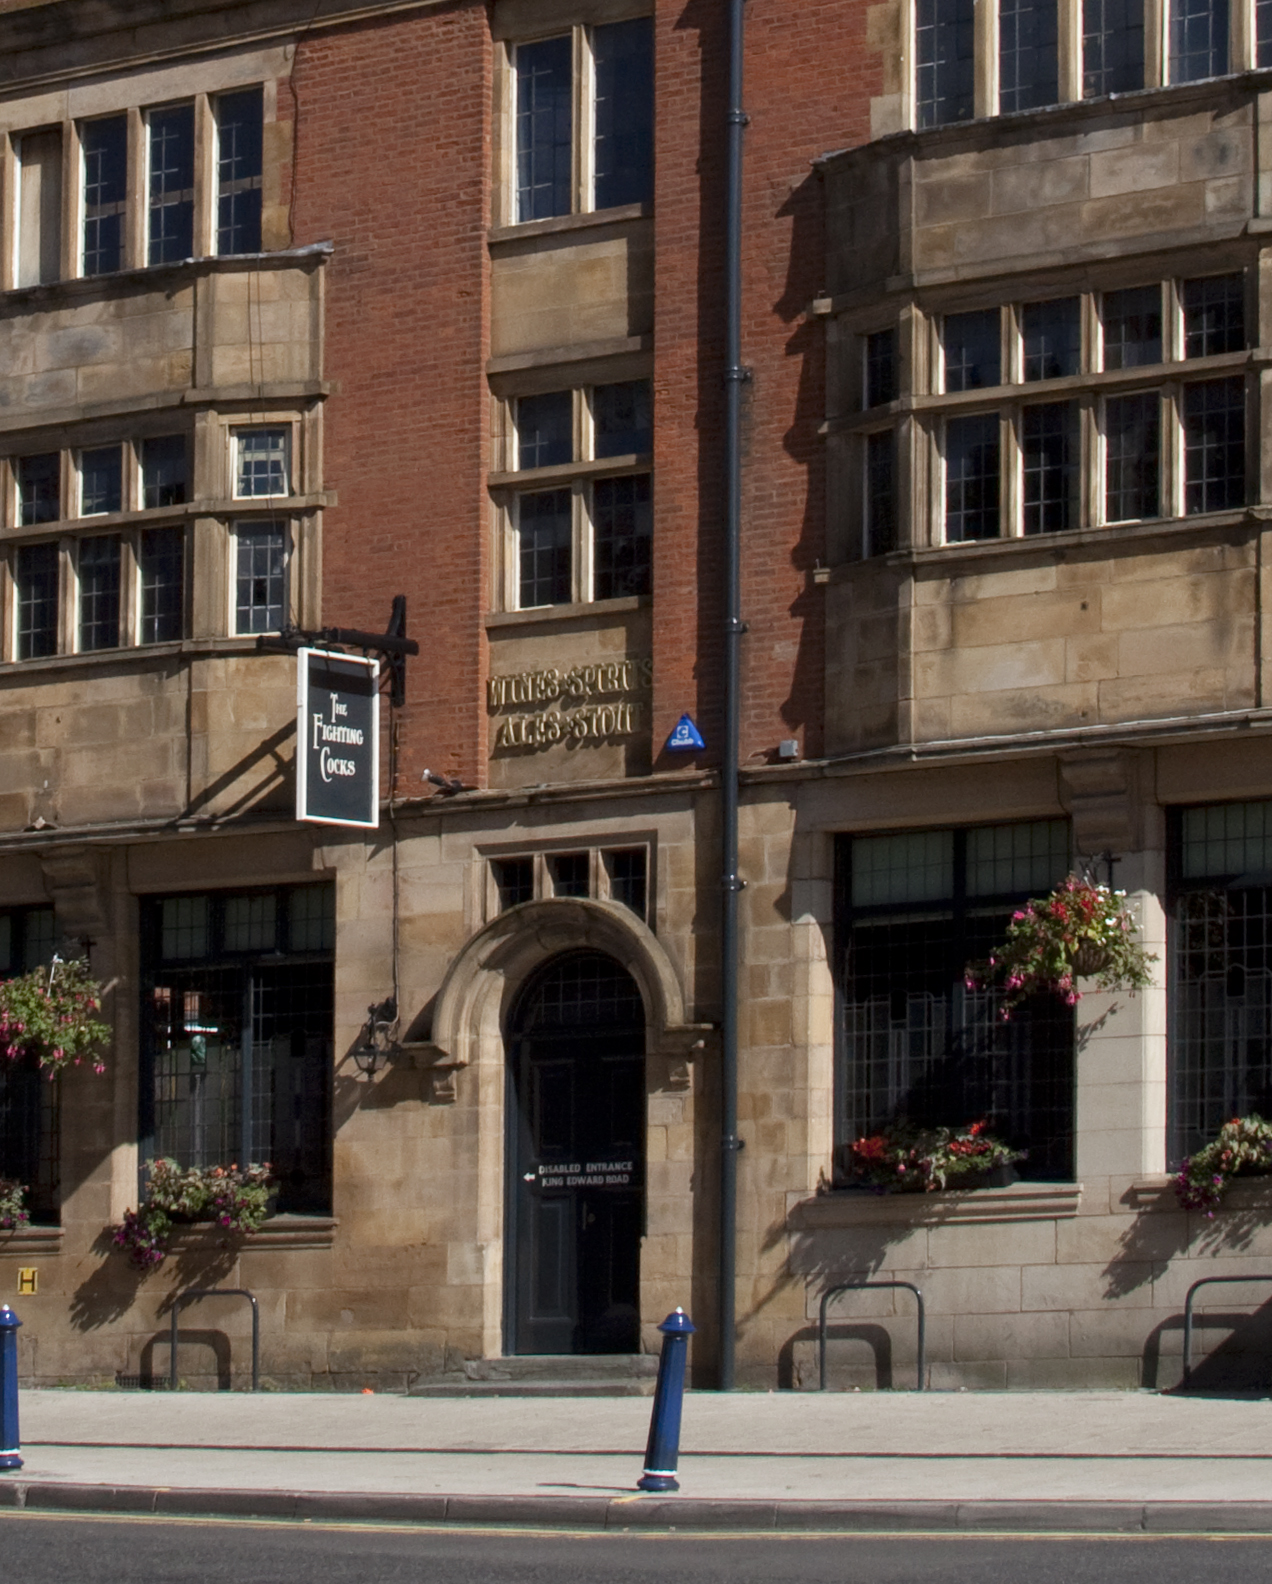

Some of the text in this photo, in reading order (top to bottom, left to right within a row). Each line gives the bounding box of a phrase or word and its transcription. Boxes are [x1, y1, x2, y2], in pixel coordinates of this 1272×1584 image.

[488, 668, 560, 706] WINES
[313, 713, 364, 750] FIGHTING
[501, 710, 561, 747] ALES
[320, 746, 356, 783] COCKS
[538, 1161, 633, 1175] DISABLED ENTRANCE
[542, 1174, 630, 1187] KING EDWARD ROAD
[19, 1269, 36, 1293] H
